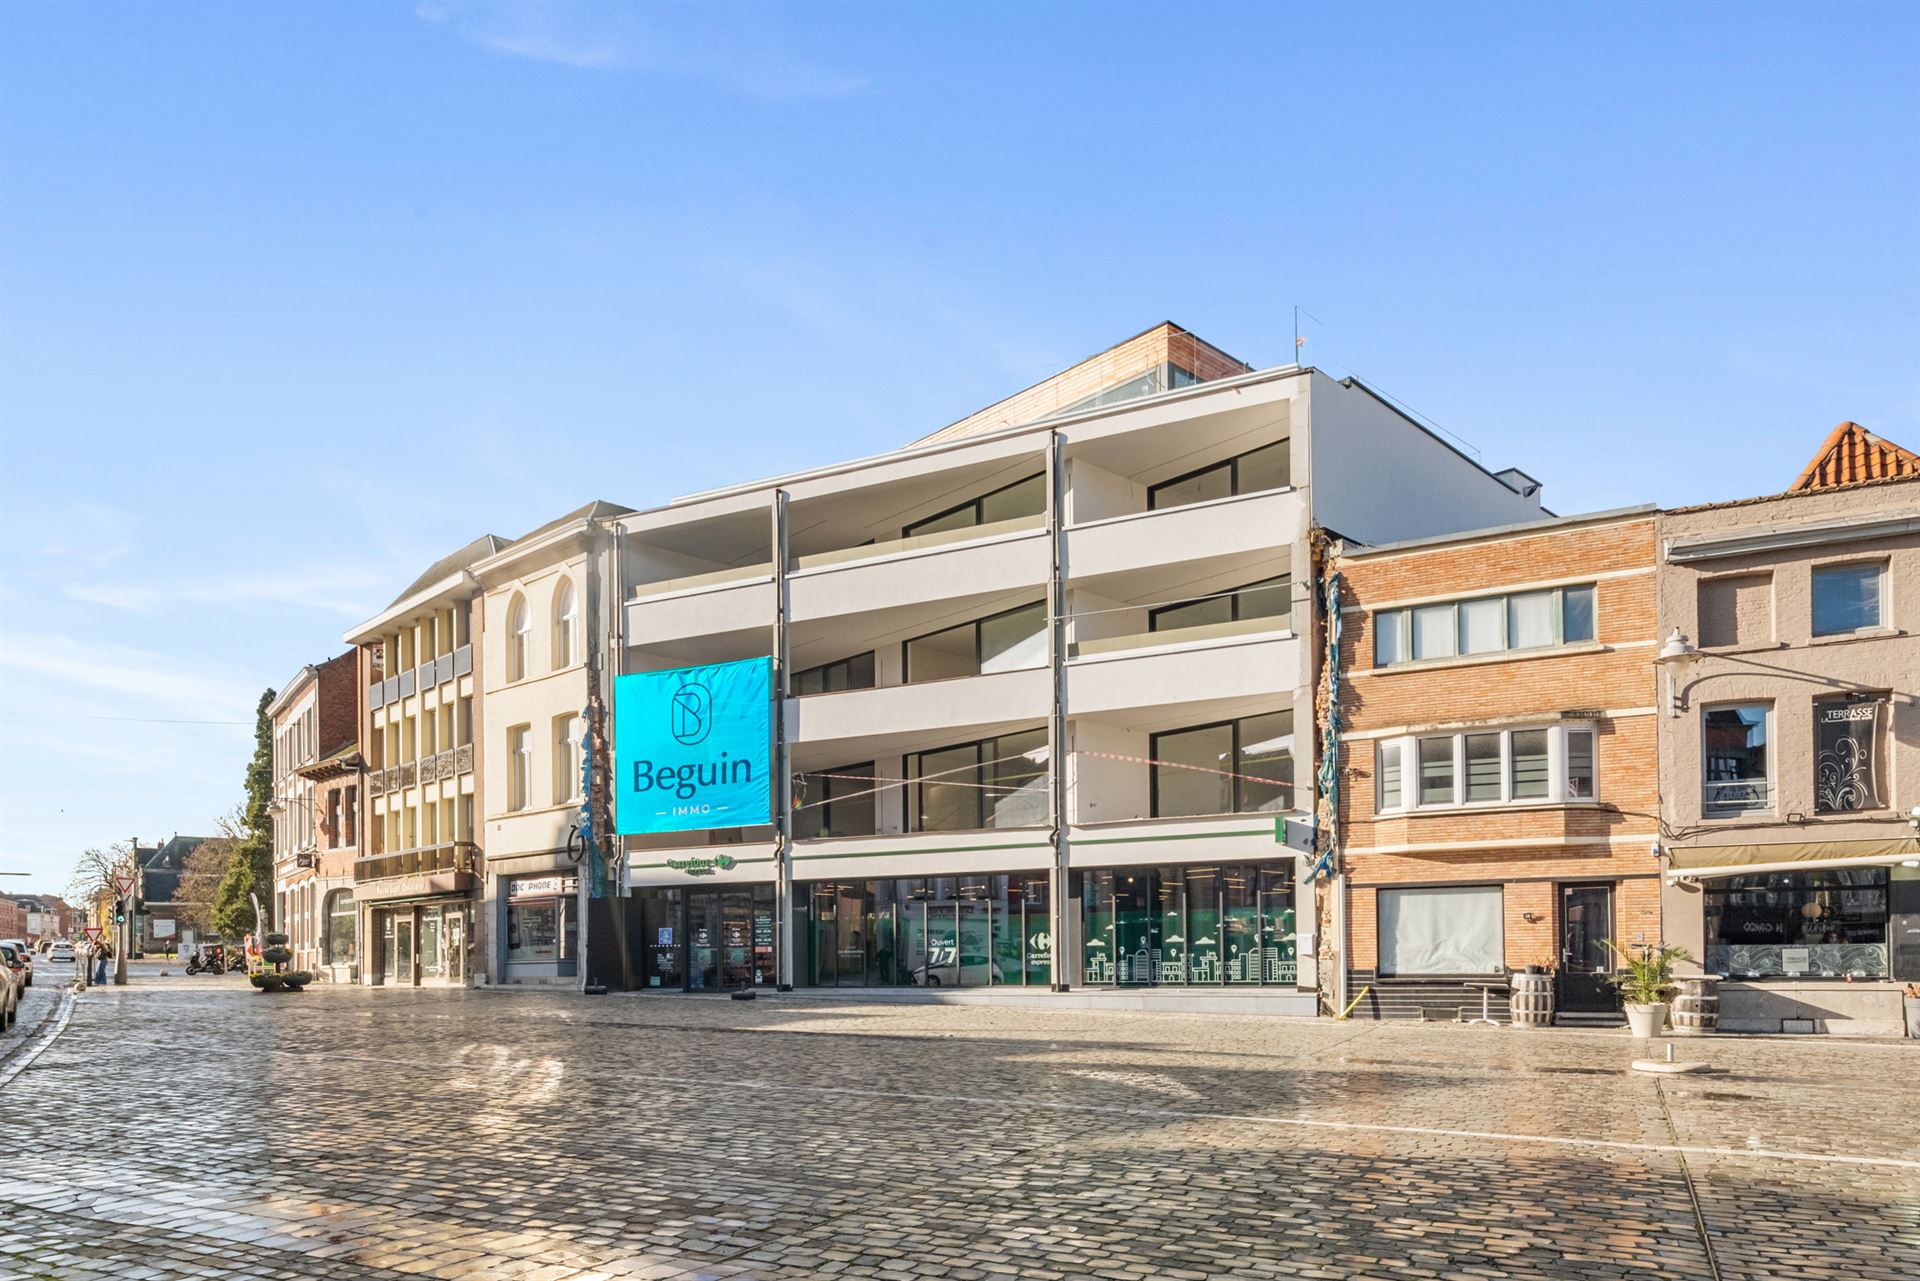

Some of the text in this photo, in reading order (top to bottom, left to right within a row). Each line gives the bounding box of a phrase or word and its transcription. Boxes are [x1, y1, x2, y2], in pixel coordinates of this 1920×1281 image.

[1826, 707, 1873, 719] TERRASSE
[633, 751, 752, 800] Beguin
[672, 804, 712, 816] IMMO
[528, 881, 552, 890] PHONE
[928, 947, 957, 963] 7/7
[1026, 951, 1051, 959] Carrefo
